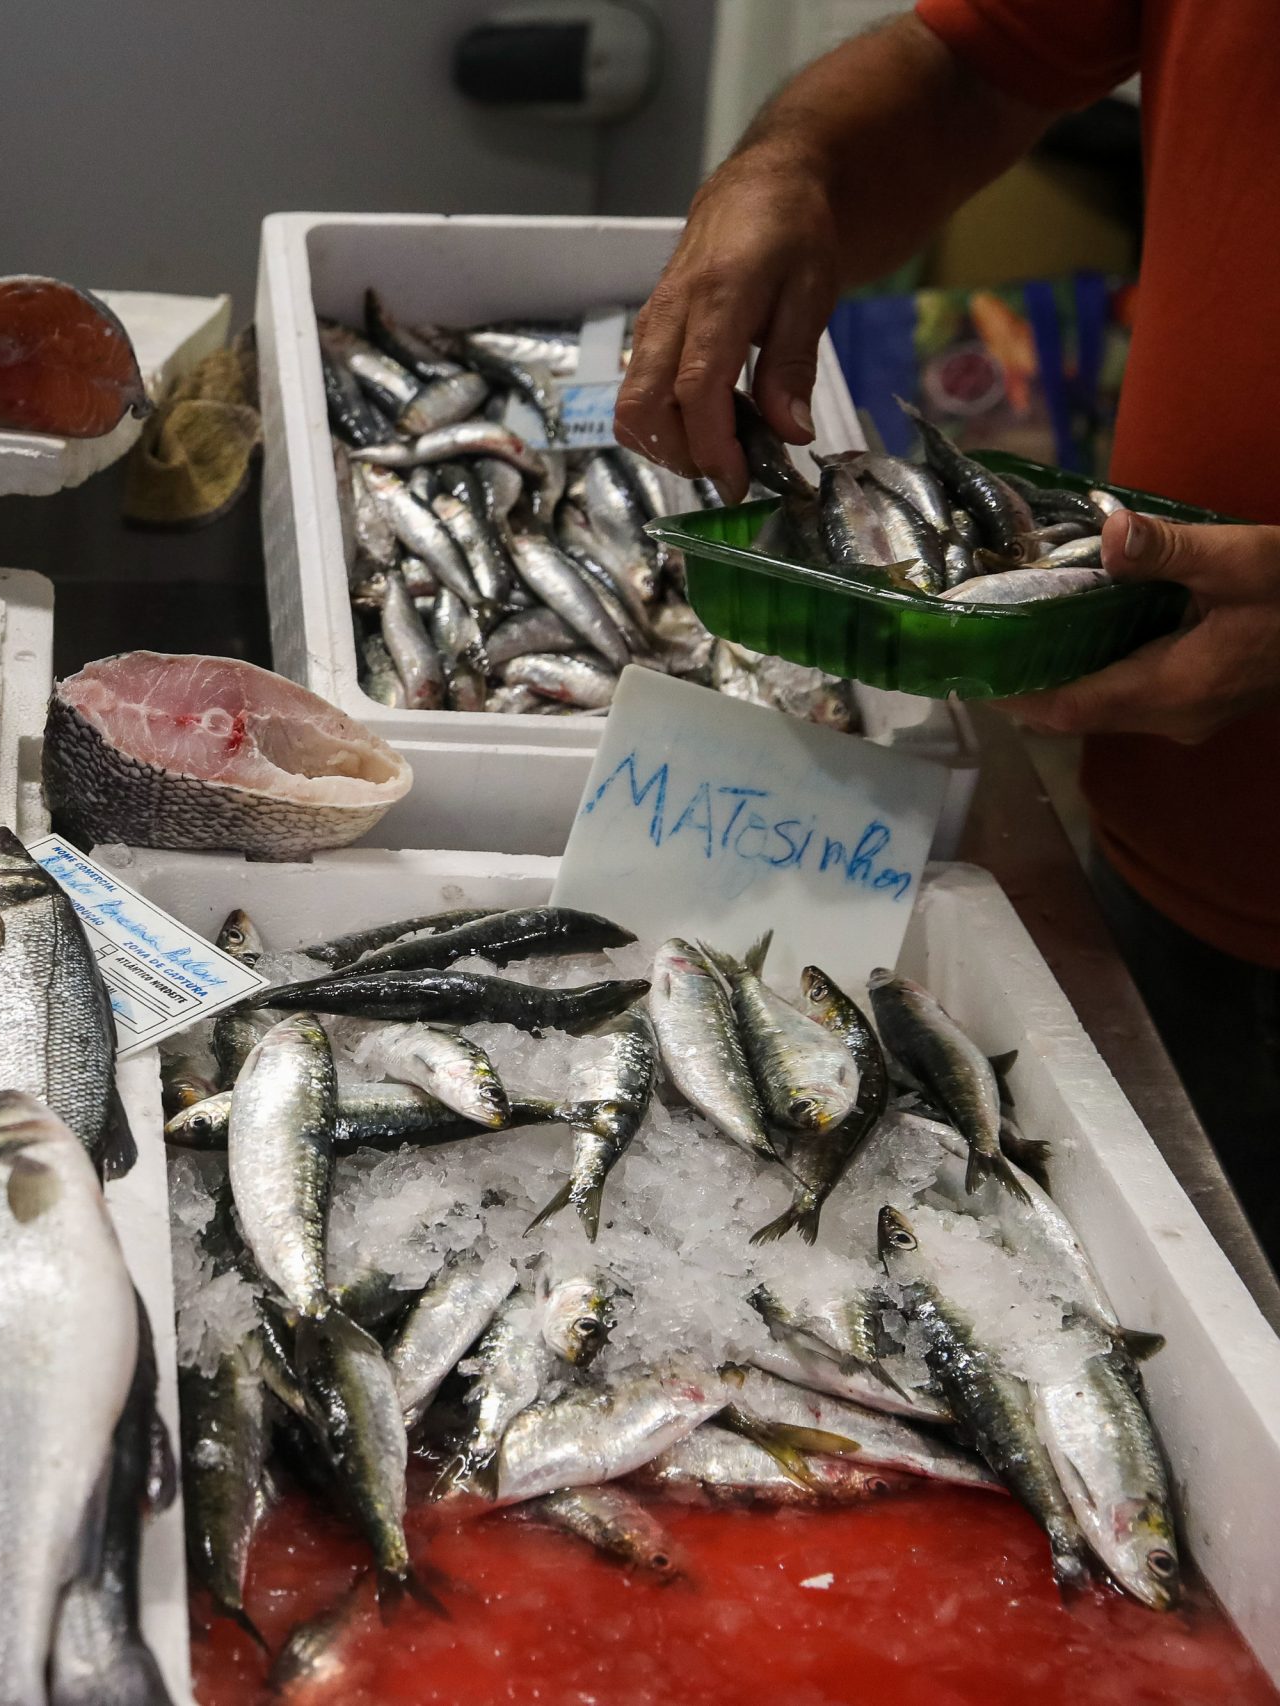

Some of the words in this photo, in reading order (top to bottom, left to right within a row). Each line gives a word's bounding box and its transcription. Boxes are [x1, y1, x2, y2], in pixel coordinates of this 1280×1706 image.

[51, 846, 78, 863] NOME
[75, 862, 118, 893] COMERCIAL
[123, 941, 151, 959] ZONA
[149, 958, 166, 969] DE
[163, 968, 209, 997] CAPTURA
[150, 980, 188, 1004] NORDESTE
